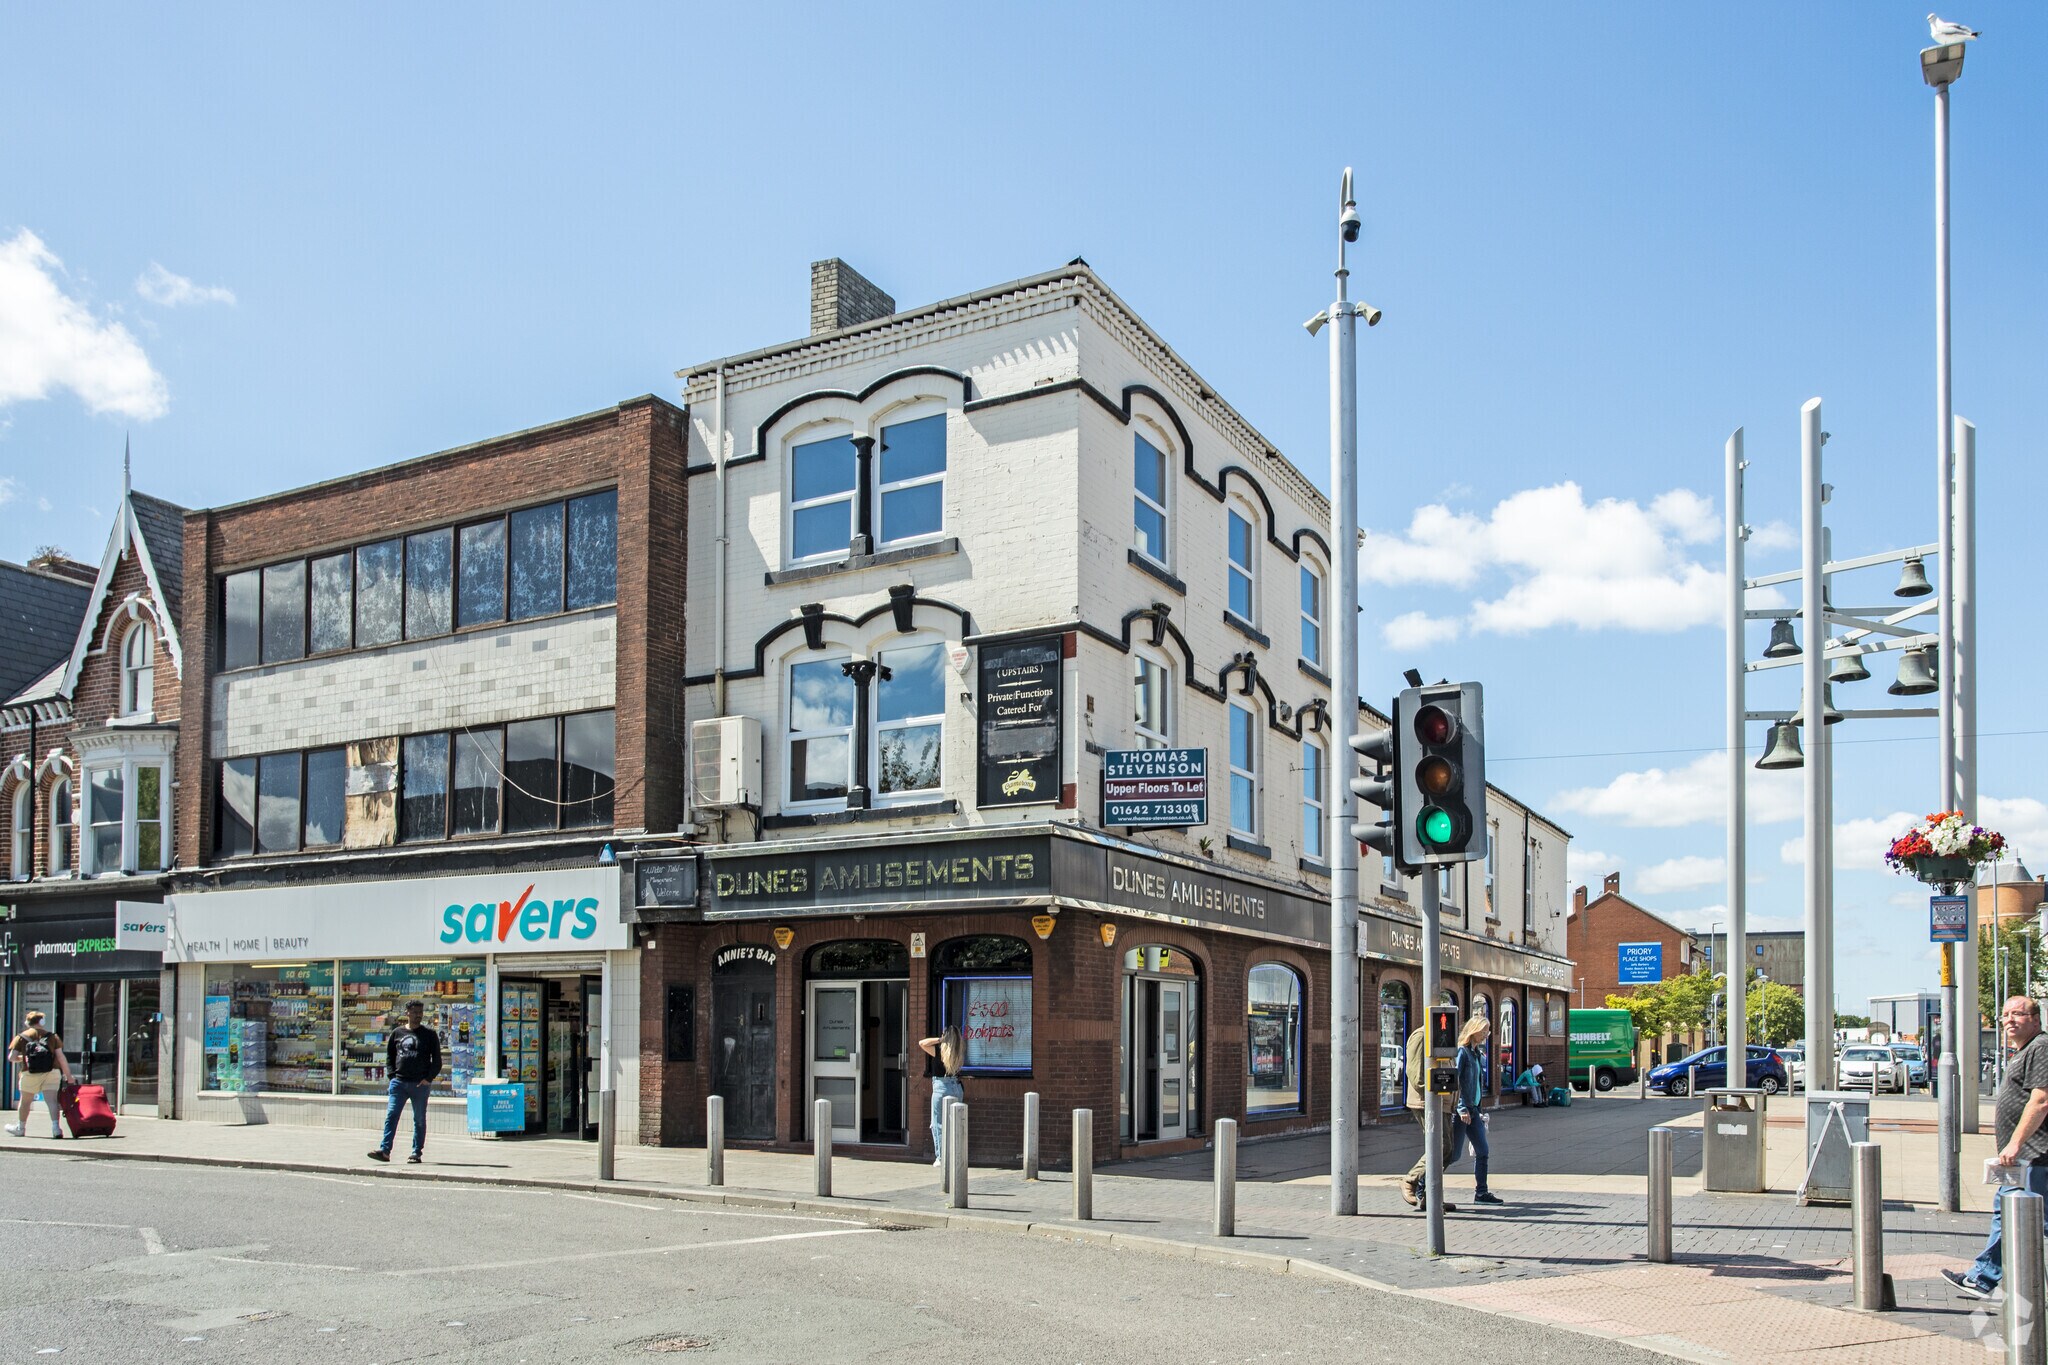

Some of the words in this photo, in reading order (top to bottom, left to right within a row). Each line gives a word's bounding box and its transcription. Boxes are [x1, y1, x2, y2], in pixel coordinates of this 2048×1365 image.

[987, 693, 1014, 703] Private
[1015, 688, 1053, 699] Functions
[997, 704, 1027, 716] Catered
[1028, 703, 1042, 712] For
[1121, 751, 1188, 763] THOMAS
[1108, 763, 1201, 775] STEVENSON
[1106, 783, 1136, 796] Upper
[1138, 782, 1169, 793] Floors
[1172, 782, 1184, 792] To
[1187, 781, 1203, 792] Let
[1112, 805, 1148, 815] 01642
[717, 868, 807, 897] DUNES
[818, 853, 1034, 891] AMUSEMENTS
[656, 888, 680, 897] Welcome
[1113, 866, 1166, 899] DUNES
[1171, 880, 1265, 919] AMUSEMENTS
[440, 883, 599, 943] savers
[123, 922, 166, 933] savers
[187, 941, 220, 953] HEALTH
[233, 939, 260, 951] HOME
[273, 937, 309, 950] BEAUTY
[1391, 930, 1414, 950] DUNES
[718, 947, 754, 966] ANNIE'S
[756, 948, 776, 965] BAR
[1570, 1033, 1611, 1041] SUNBELT
